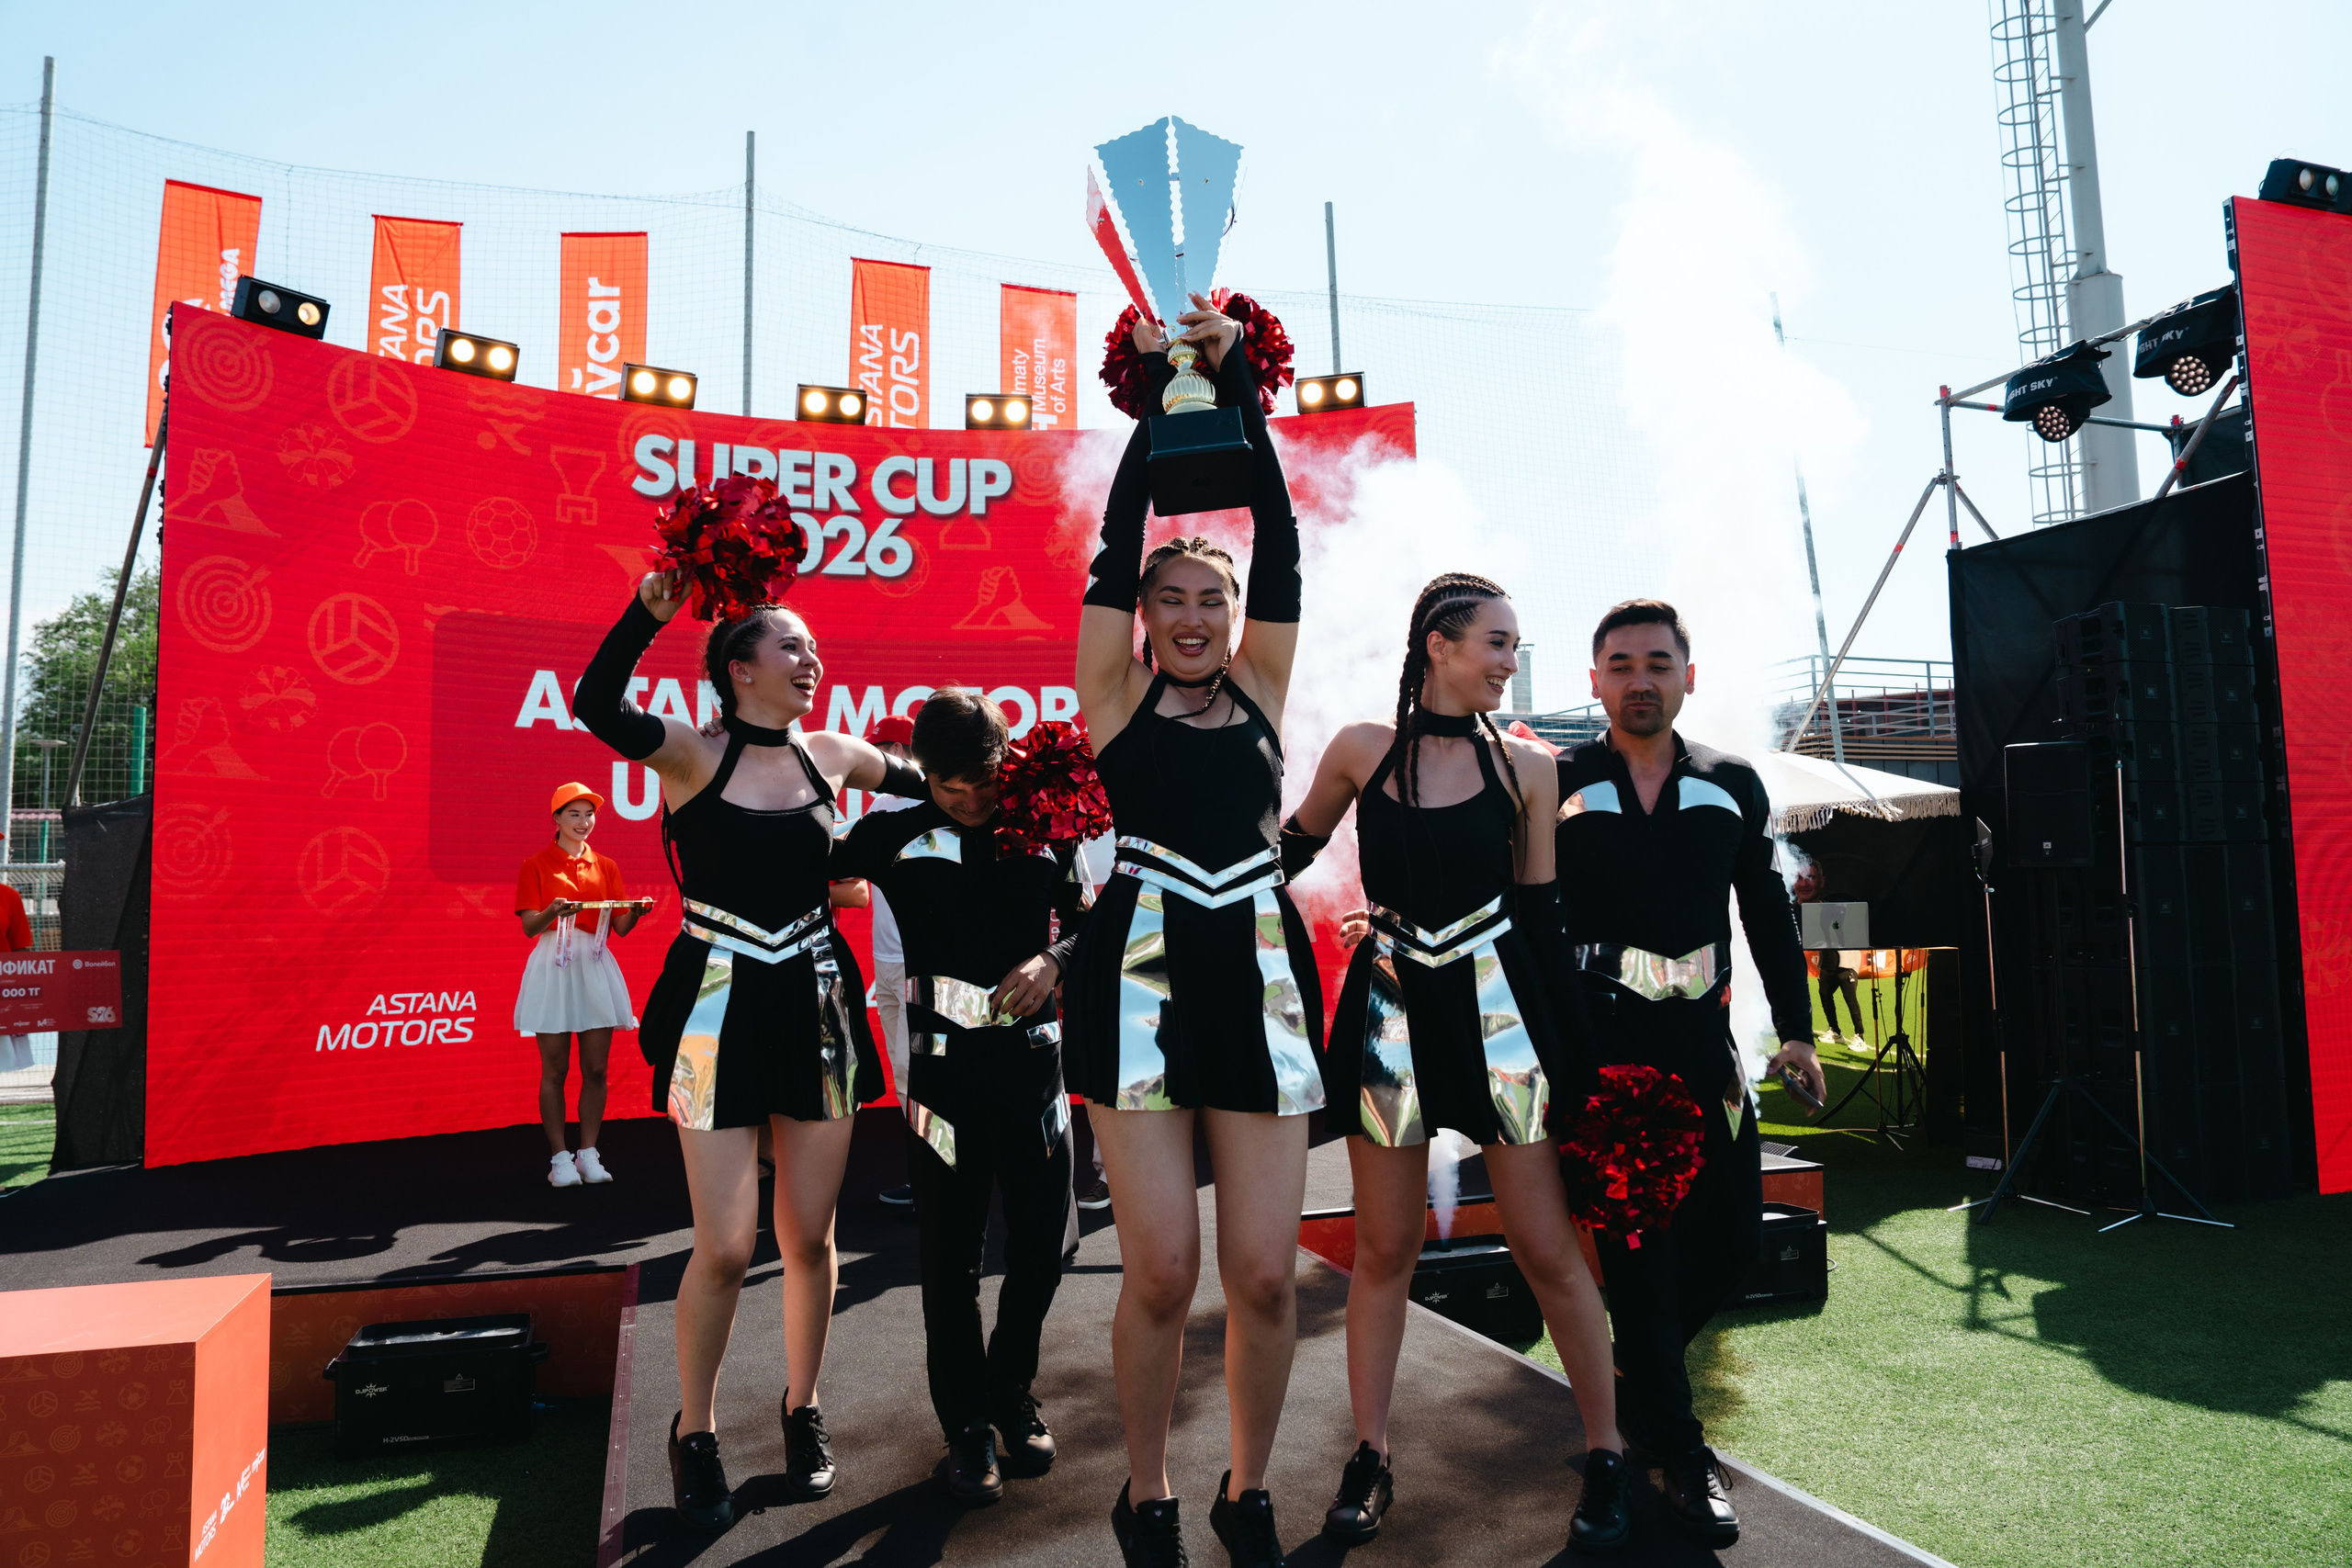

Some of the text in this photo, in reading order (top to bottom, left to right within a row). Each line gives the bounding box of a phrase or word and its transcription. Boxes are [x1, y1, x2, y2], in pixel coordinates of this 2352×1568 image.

[220, 248, 240, 316] MEGA
[859, 324, 883, 427] STANA
[890, 328, 920, 429] TORS
[1012, 348, 1029, 395] lmaty
[1032, 338, 1046, 412] Museum
[1050, 358, 1066, 413] of Arts
[2030, 378, 2053, 391] SKY
[871, 455, 1012, 515] CUP
[789, 513, 913, 578] 026
[0, 959, 55, 976] ФИКАТ
[366, 990, 477, 1016] ASTANA
[315, 1017, 475, 1052] MOTORS
